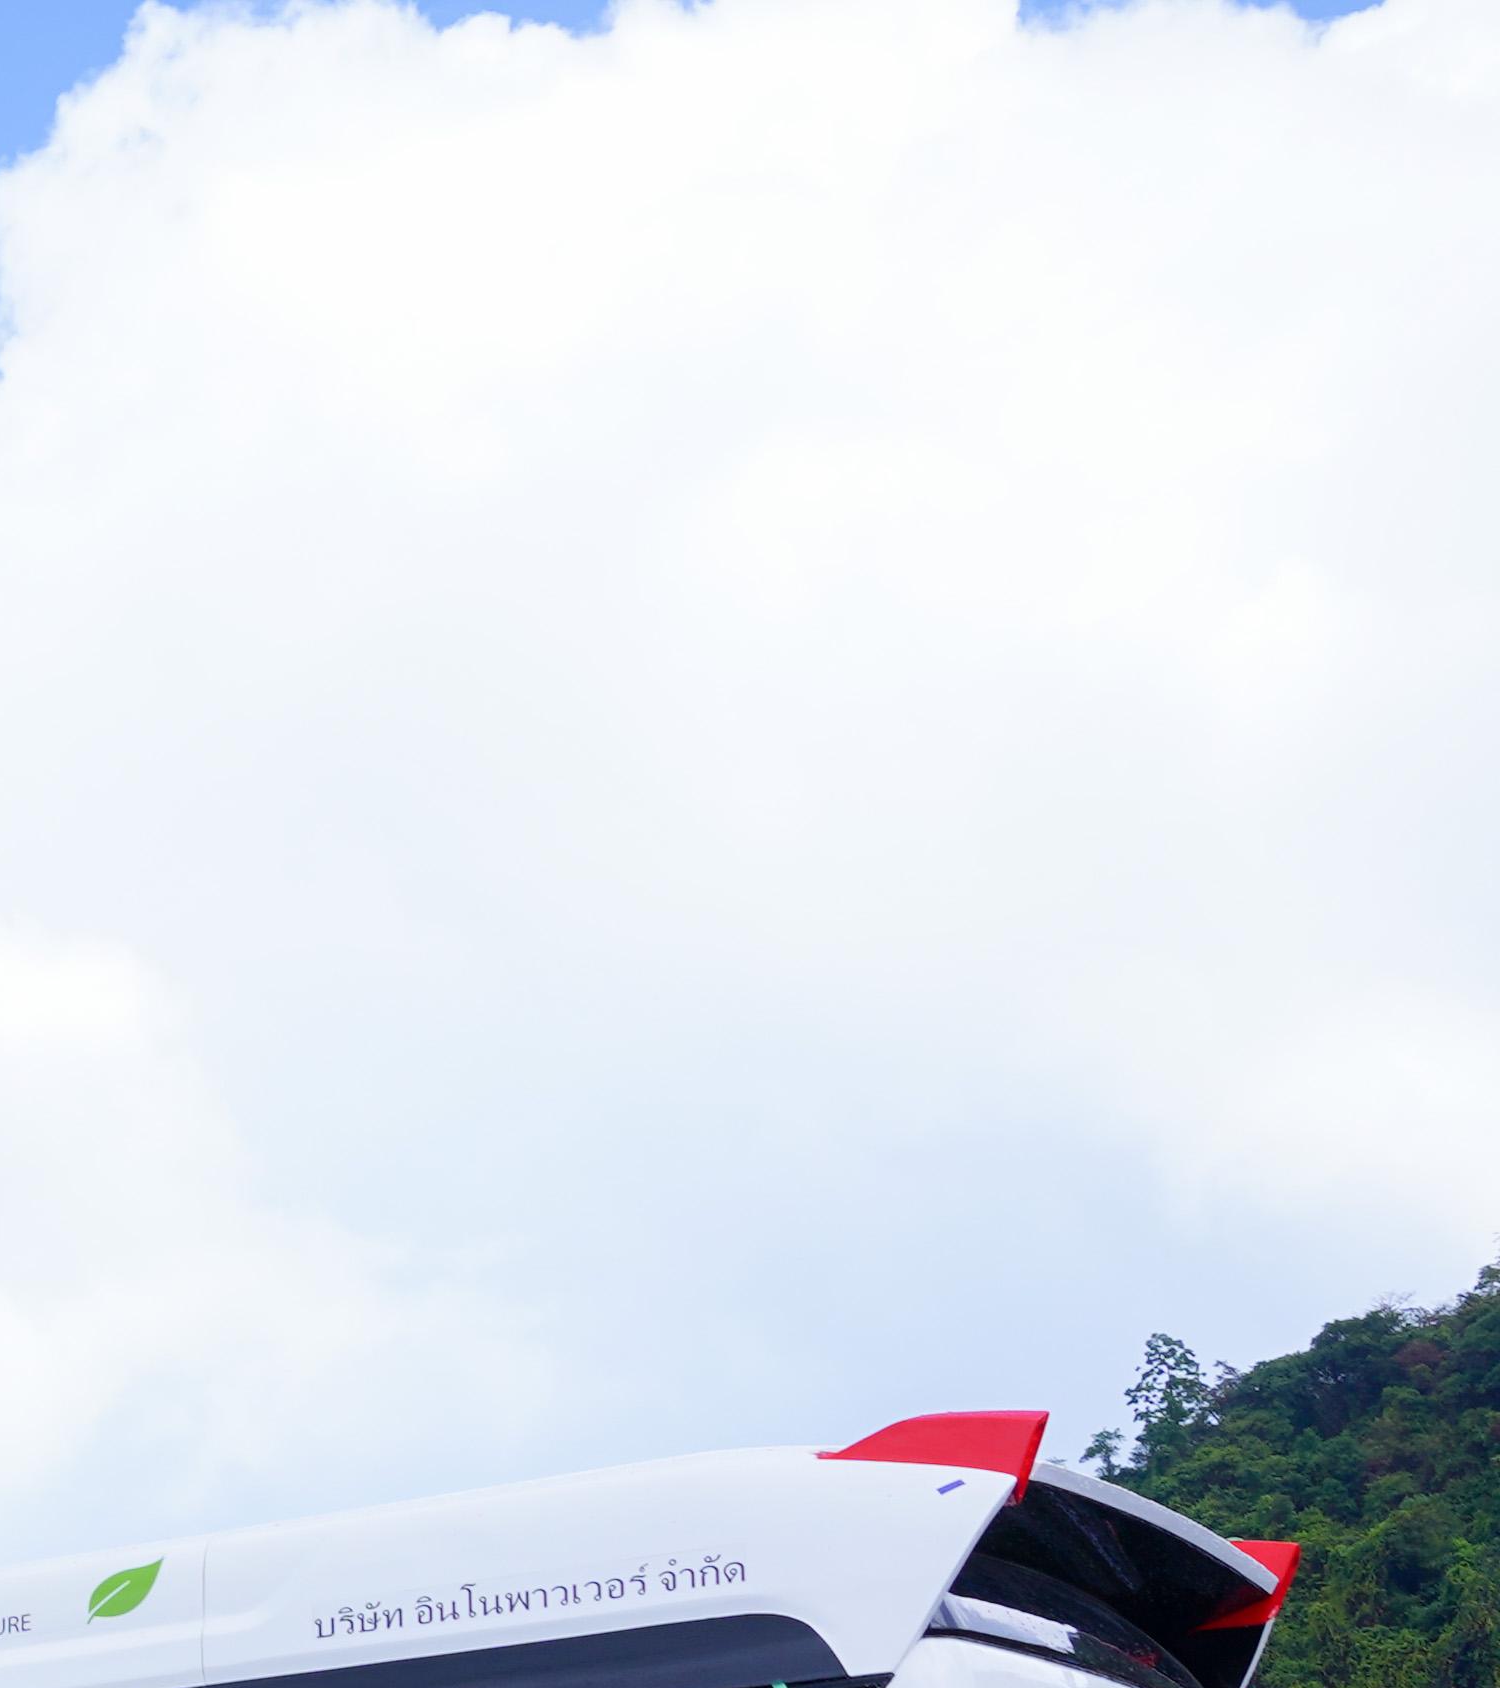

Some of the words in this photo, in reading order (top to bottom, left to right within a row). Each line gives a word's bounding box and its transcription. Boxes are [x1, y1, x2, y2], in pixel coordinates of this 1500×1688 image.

[314, 1600, 404, 1639] บริษัท
[659, 1553, 747, 1594] จำกัด
